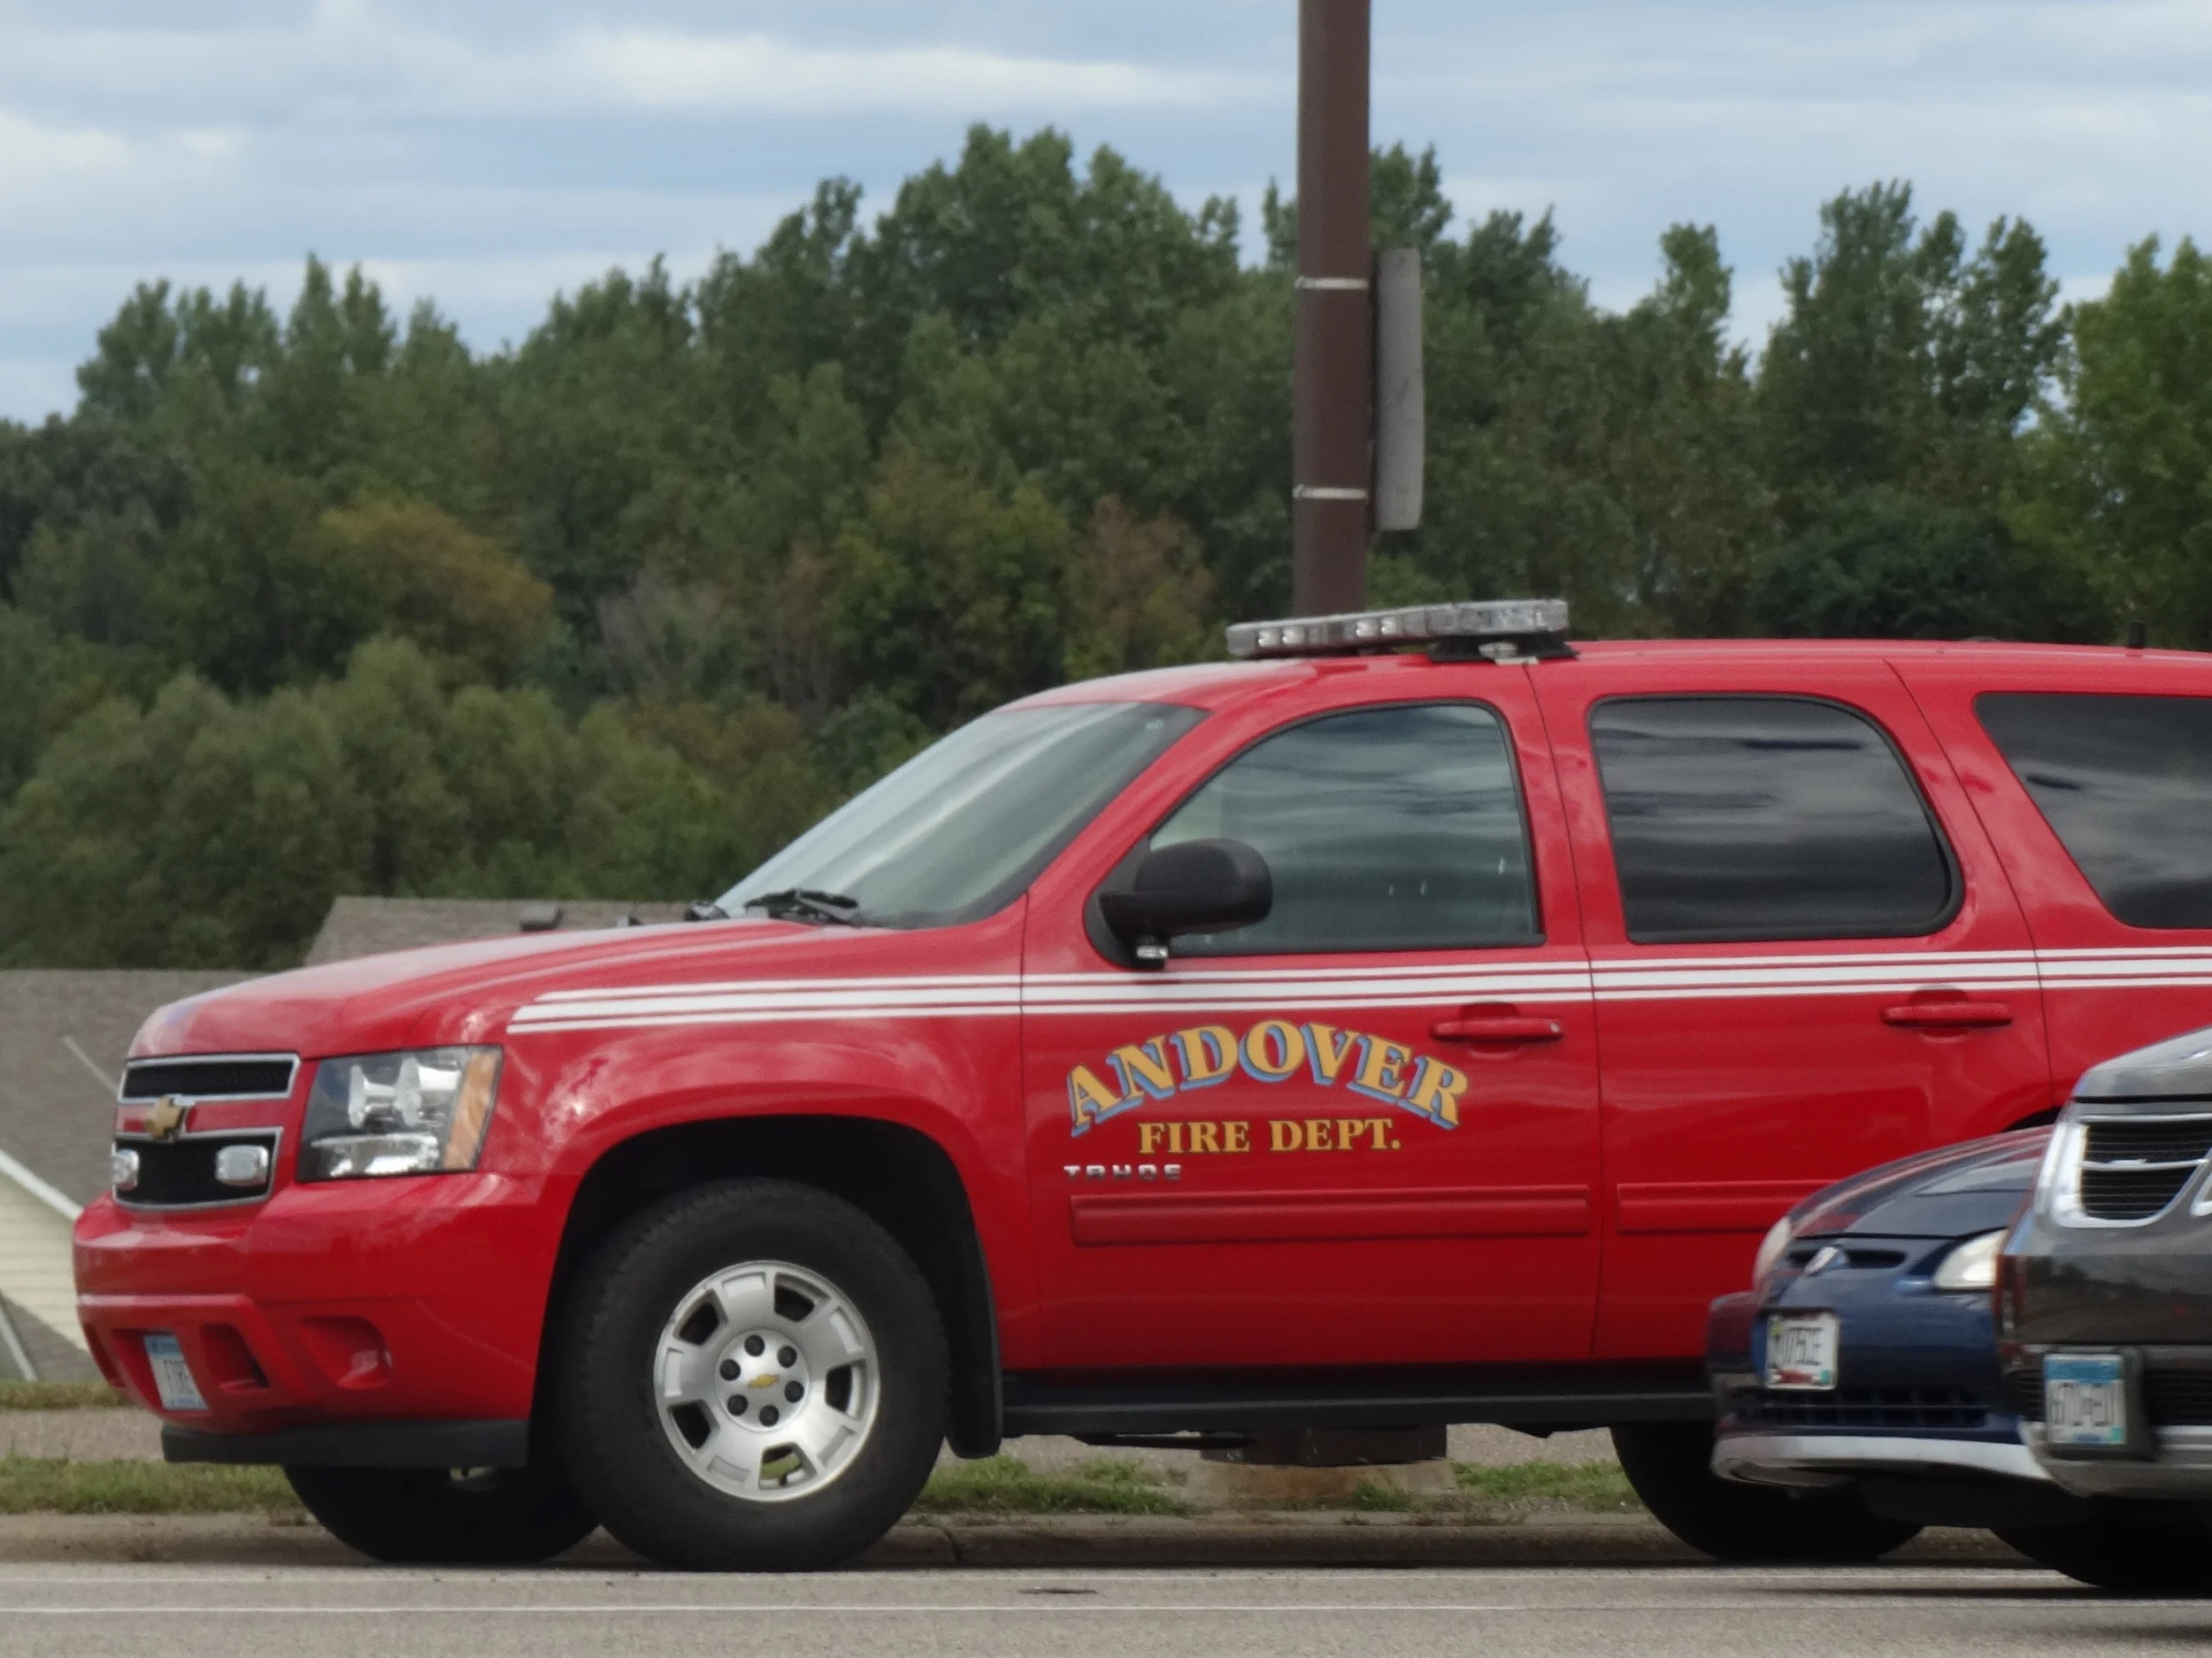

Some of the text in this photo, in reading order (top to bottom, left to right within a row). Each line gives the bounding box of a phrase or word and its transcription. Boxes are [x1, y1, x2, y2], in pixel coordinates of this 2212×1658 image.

[1066, 1019, 1469, 1137] ANDOVER
[1138, 1118, 1400, 1154] FIRE DEPT.
[1064, 1163, 1182, 1181] TAHOE
